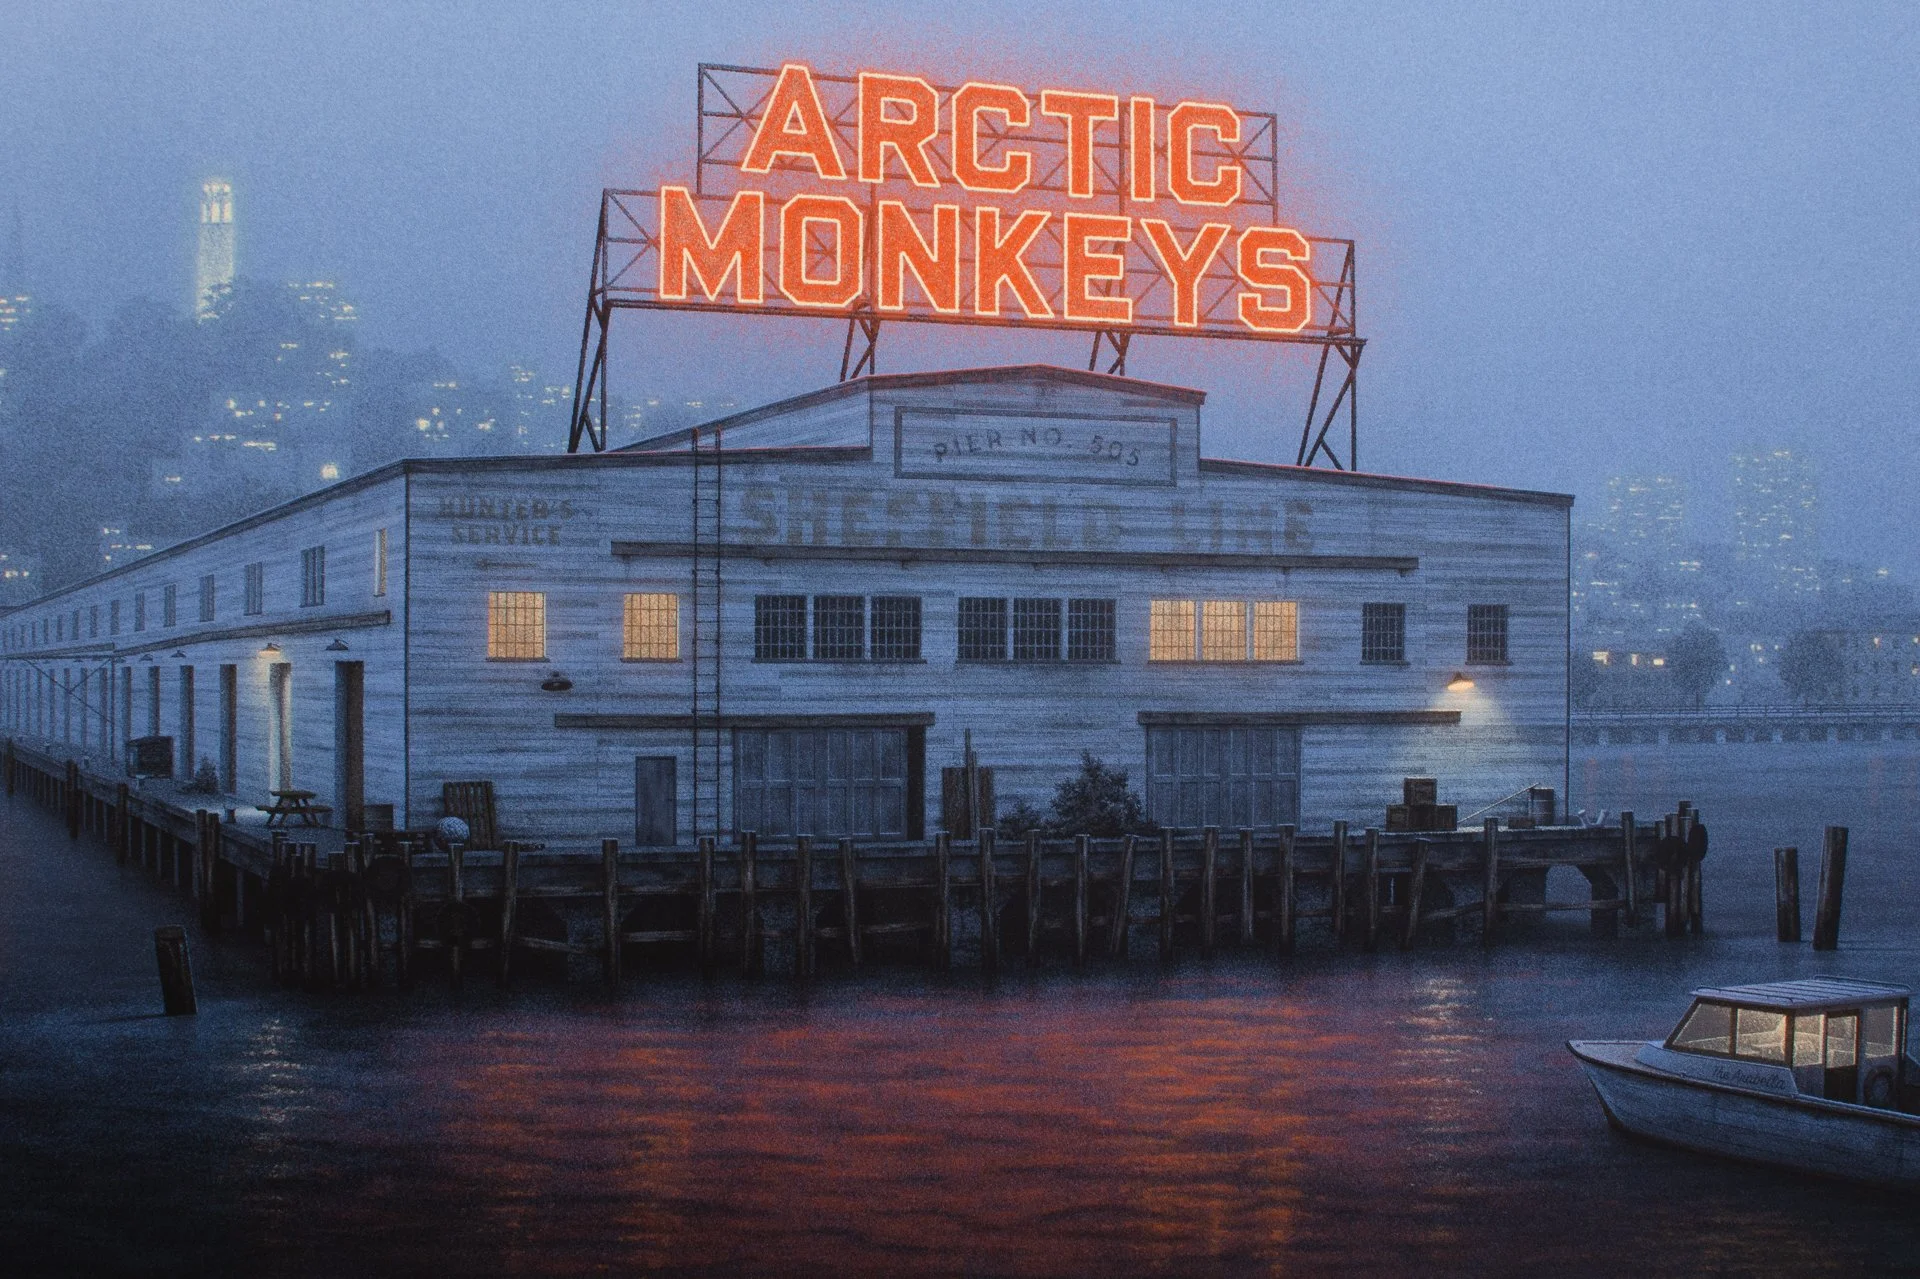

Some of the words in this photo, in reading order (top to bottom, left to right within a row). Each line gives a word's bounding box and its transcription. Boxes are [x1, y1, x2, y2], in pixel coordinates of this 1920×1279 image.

[741, 64, 1241, 208] ARCTIC
[658, 185, 1312, 333] MONKEYS
[933, 427, 1002, 463] PIER
[1090, 434, 1139, 467] 505
[452, 522, 562, 546] SERVICE
